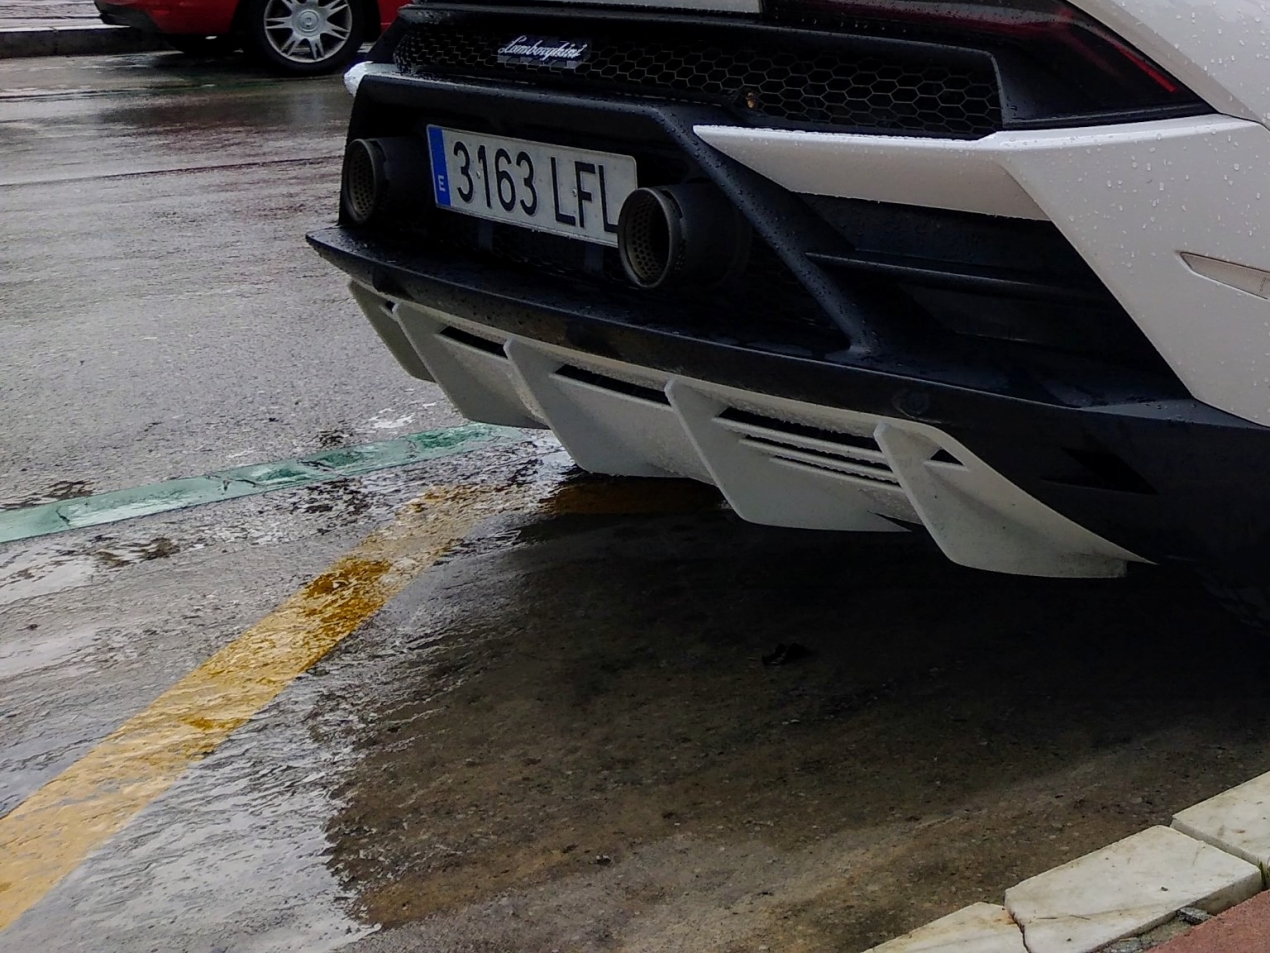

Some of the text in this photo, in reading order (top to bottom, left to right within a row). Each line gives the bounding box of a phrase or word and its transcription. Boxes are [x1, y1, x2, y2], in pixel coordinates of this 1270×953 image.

[498, 35, 587, 61] Lamborghini
[438, 174, 446, 192] E
[453, 141, 619, 233] 3163 LFL
